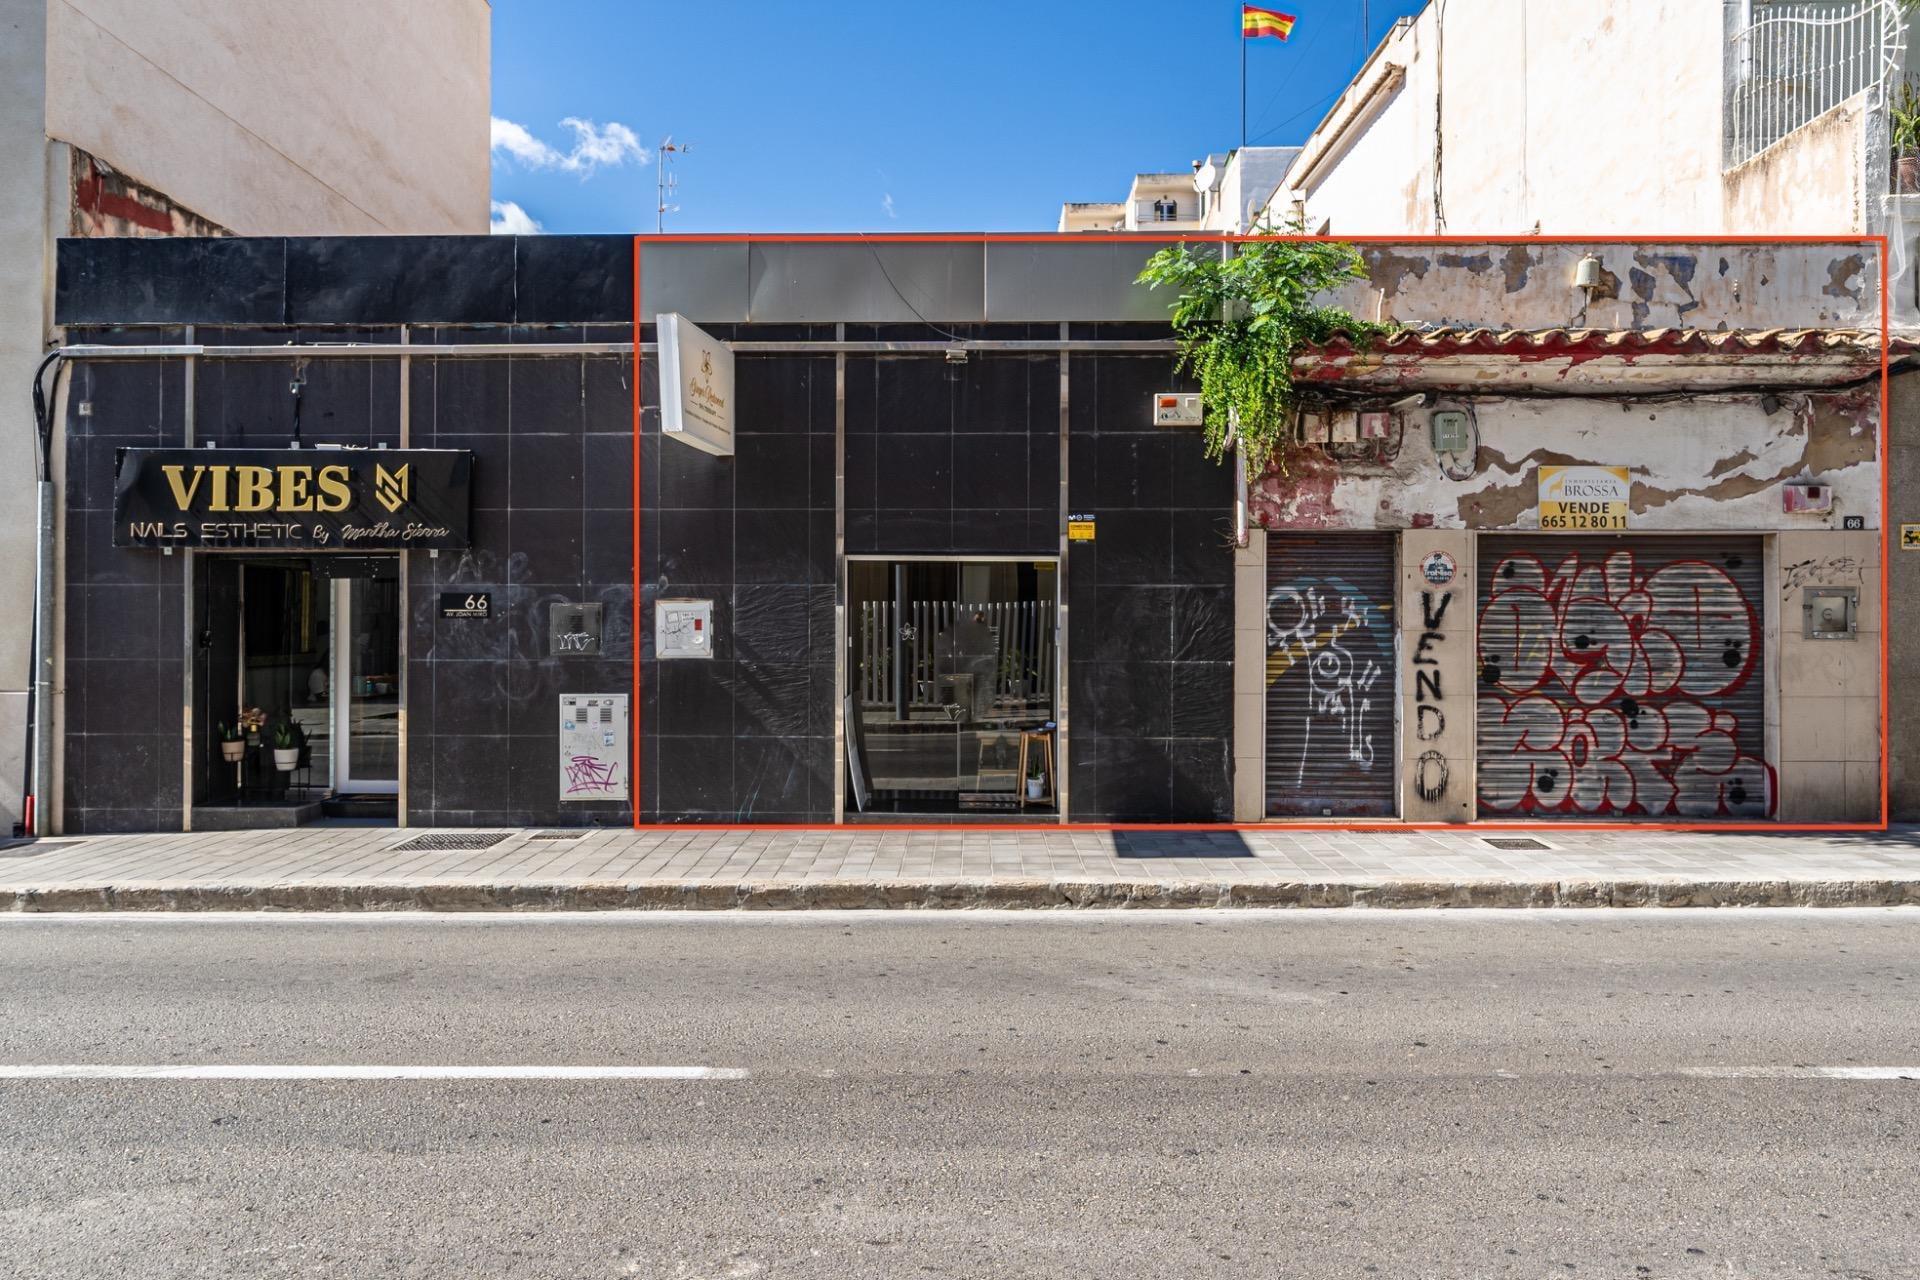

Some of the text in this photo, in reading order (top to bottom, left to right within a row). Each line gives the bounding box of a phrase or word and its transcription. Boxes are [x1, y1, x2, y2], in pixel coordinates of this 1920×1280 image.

[161, 464, 351, 512] VIBES
[1564, 484, 1619, 497] BROSSA
[1558, 502, 1610, 514] VENDE
[1541, 515, 1626, 528] 665 12 80 11
[1846, 518, 1861, 529] 66
[129, 522, 188, 538] NAILS
[200, 522, 303, 539] ESTHETIC
[312, 524, 330, 544] By
[341, 521, 401, 540] Martha
[464, 594, 488, 609] 66
[1412, 590, 1453, 803] VENDO
